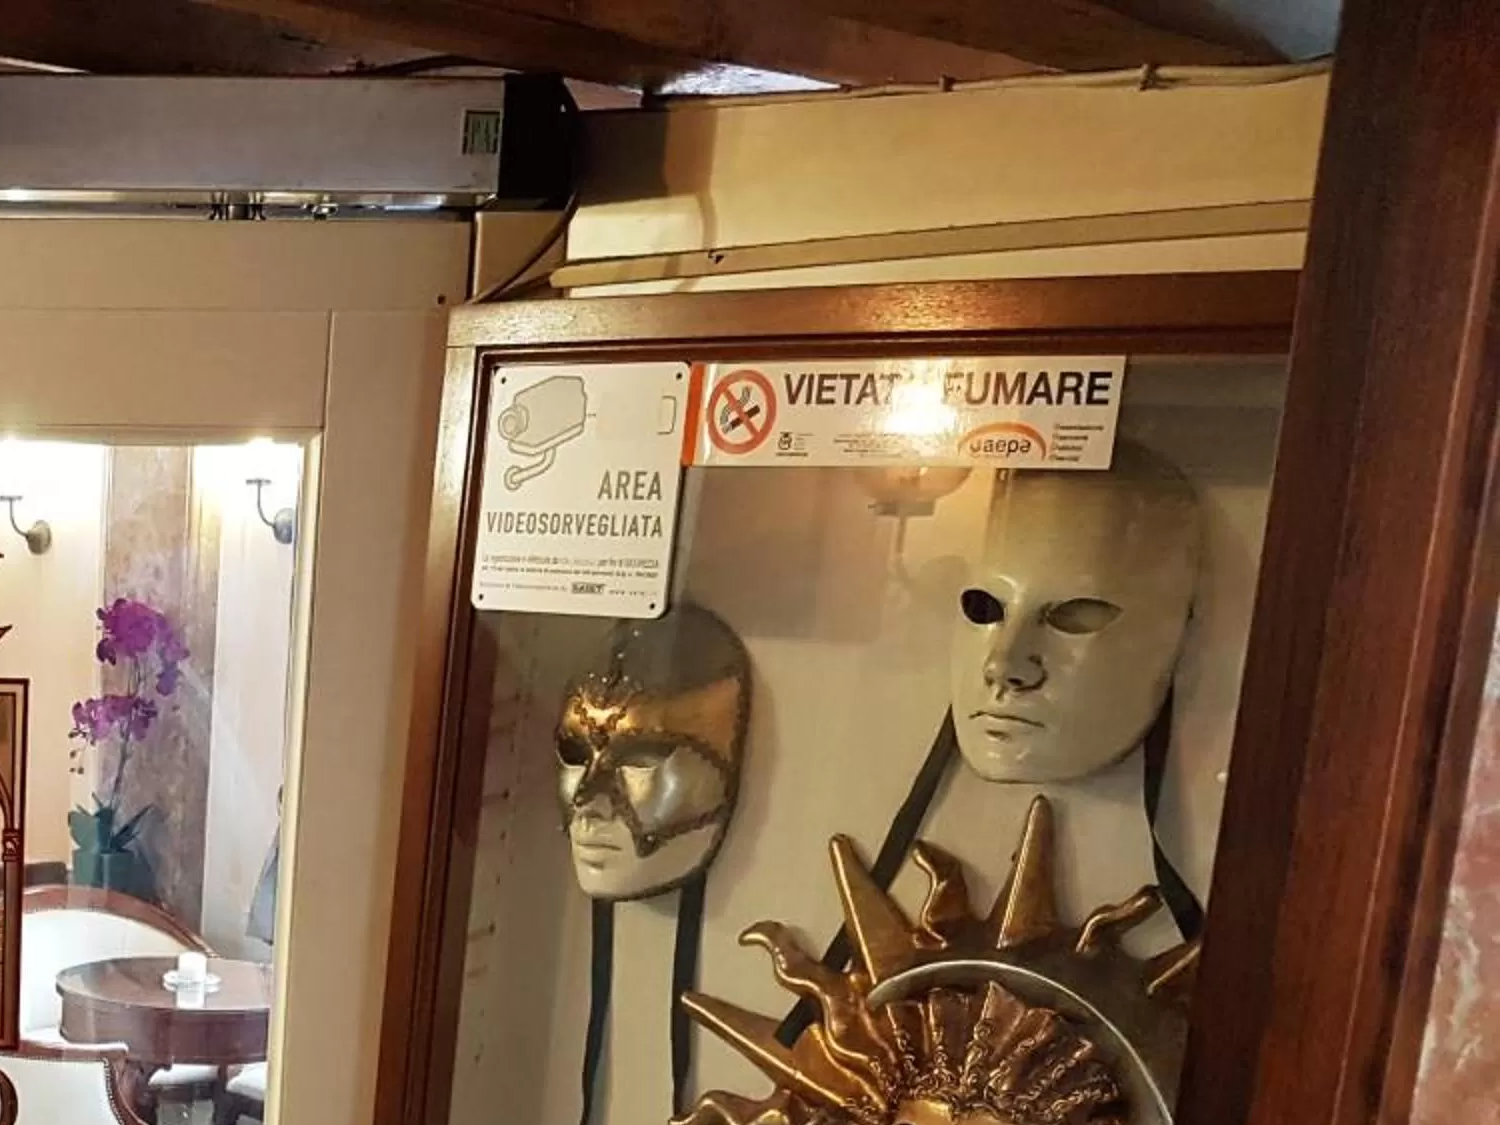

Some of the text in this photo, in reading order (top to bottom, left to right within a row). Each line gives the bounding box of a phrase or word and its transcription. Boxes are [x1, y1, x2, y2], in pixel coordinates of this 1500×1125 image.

[783, 371, 1113, 406] VIETAT FUMARE
[597, 470, 663, 500] AREA
[486, 511, 664, 538] VIDEOSORVEGLIATA
